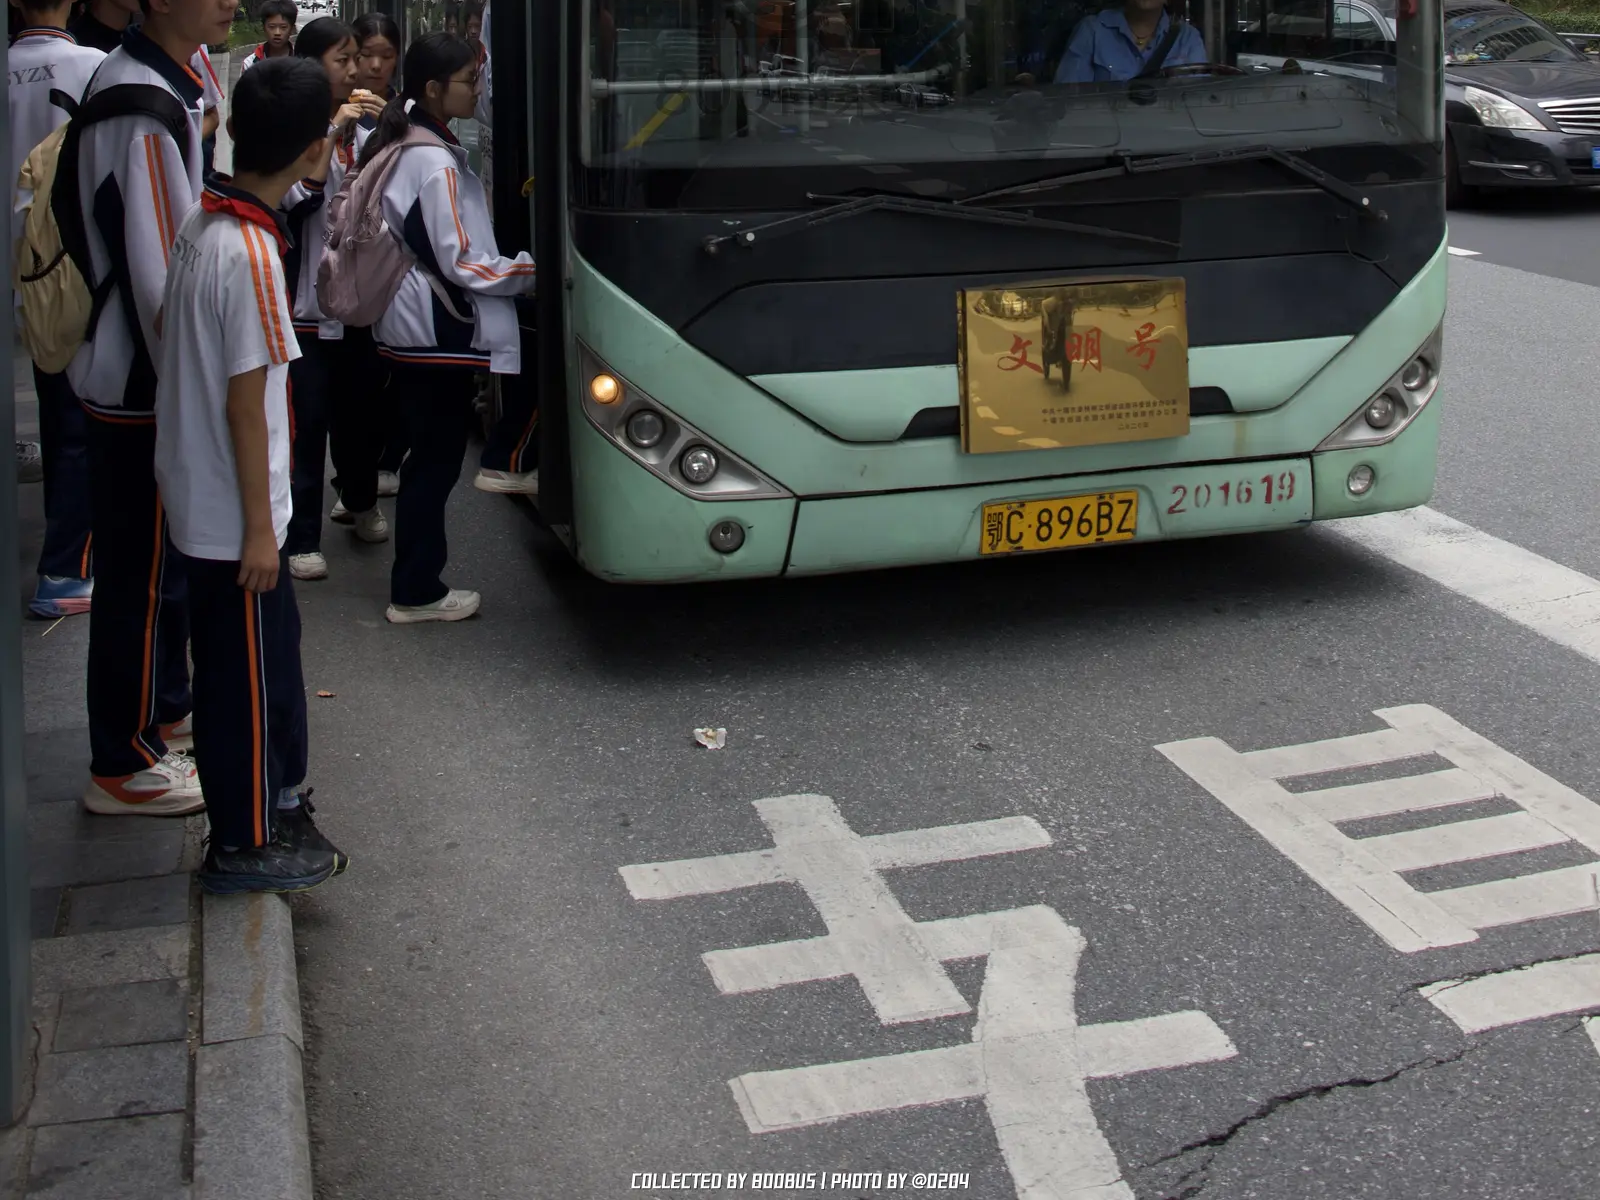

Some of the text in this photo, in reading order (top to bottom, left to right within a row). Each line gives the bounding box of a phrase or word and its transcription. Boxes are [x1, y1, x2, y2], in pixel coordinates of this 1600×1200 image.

[8, 63, 57, 86] YZX
[997, 322, 1163, 374] 文明号
